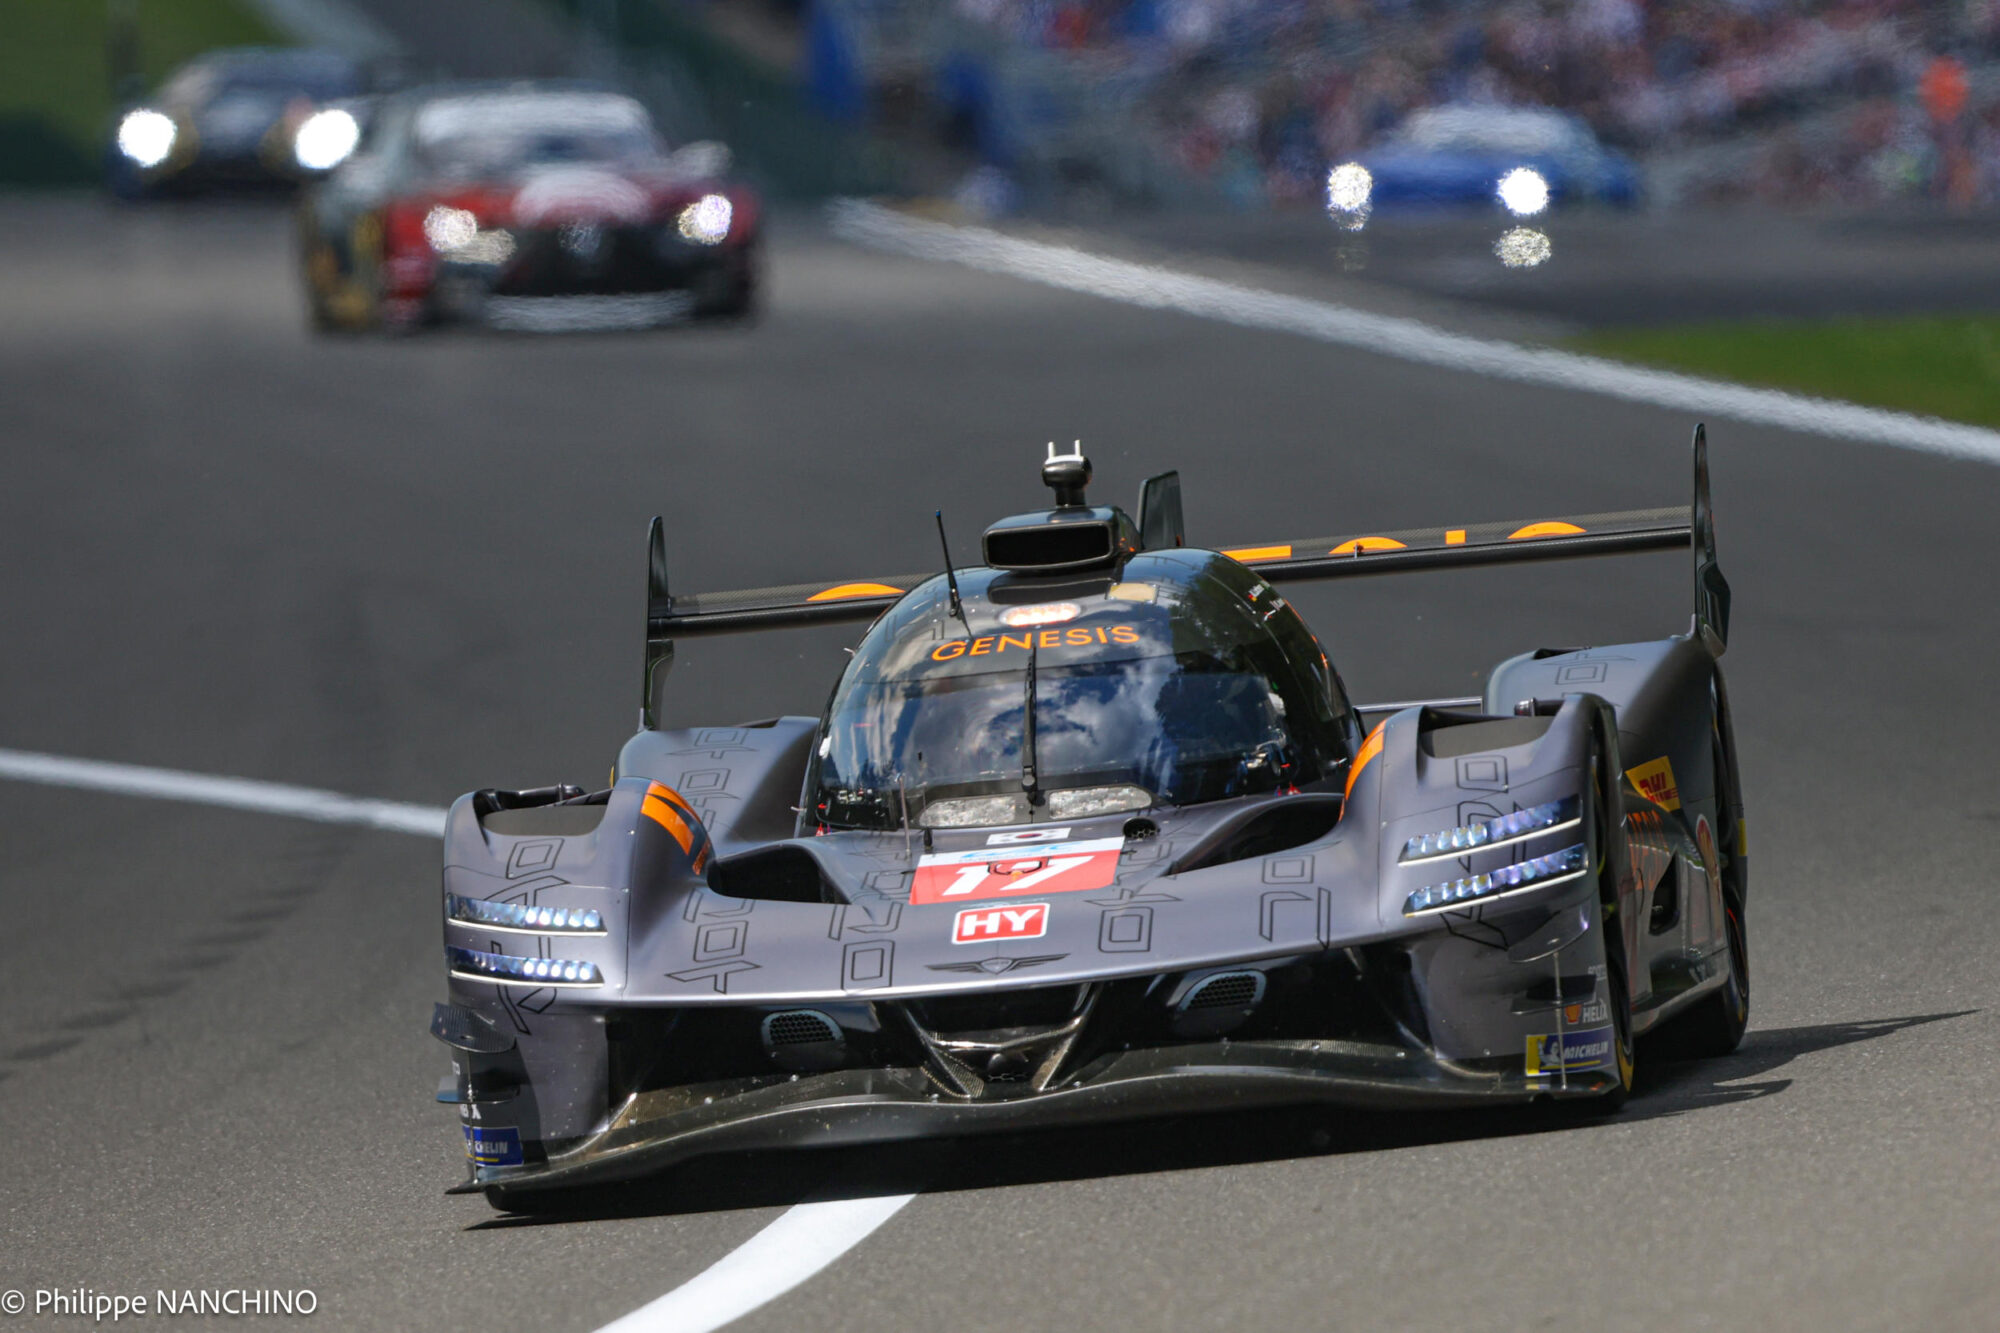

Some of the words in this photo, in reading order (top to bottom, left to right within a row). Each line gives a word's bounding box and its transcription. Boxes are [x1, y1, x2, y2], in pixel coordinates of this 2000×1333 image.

[931, 626, 1140, 661] GENESIS
[942, 855, 1095, 896] 17
[961, 908, 1041, 937] HY
[1563, 1041, 1609, 1059] MICHELIN
